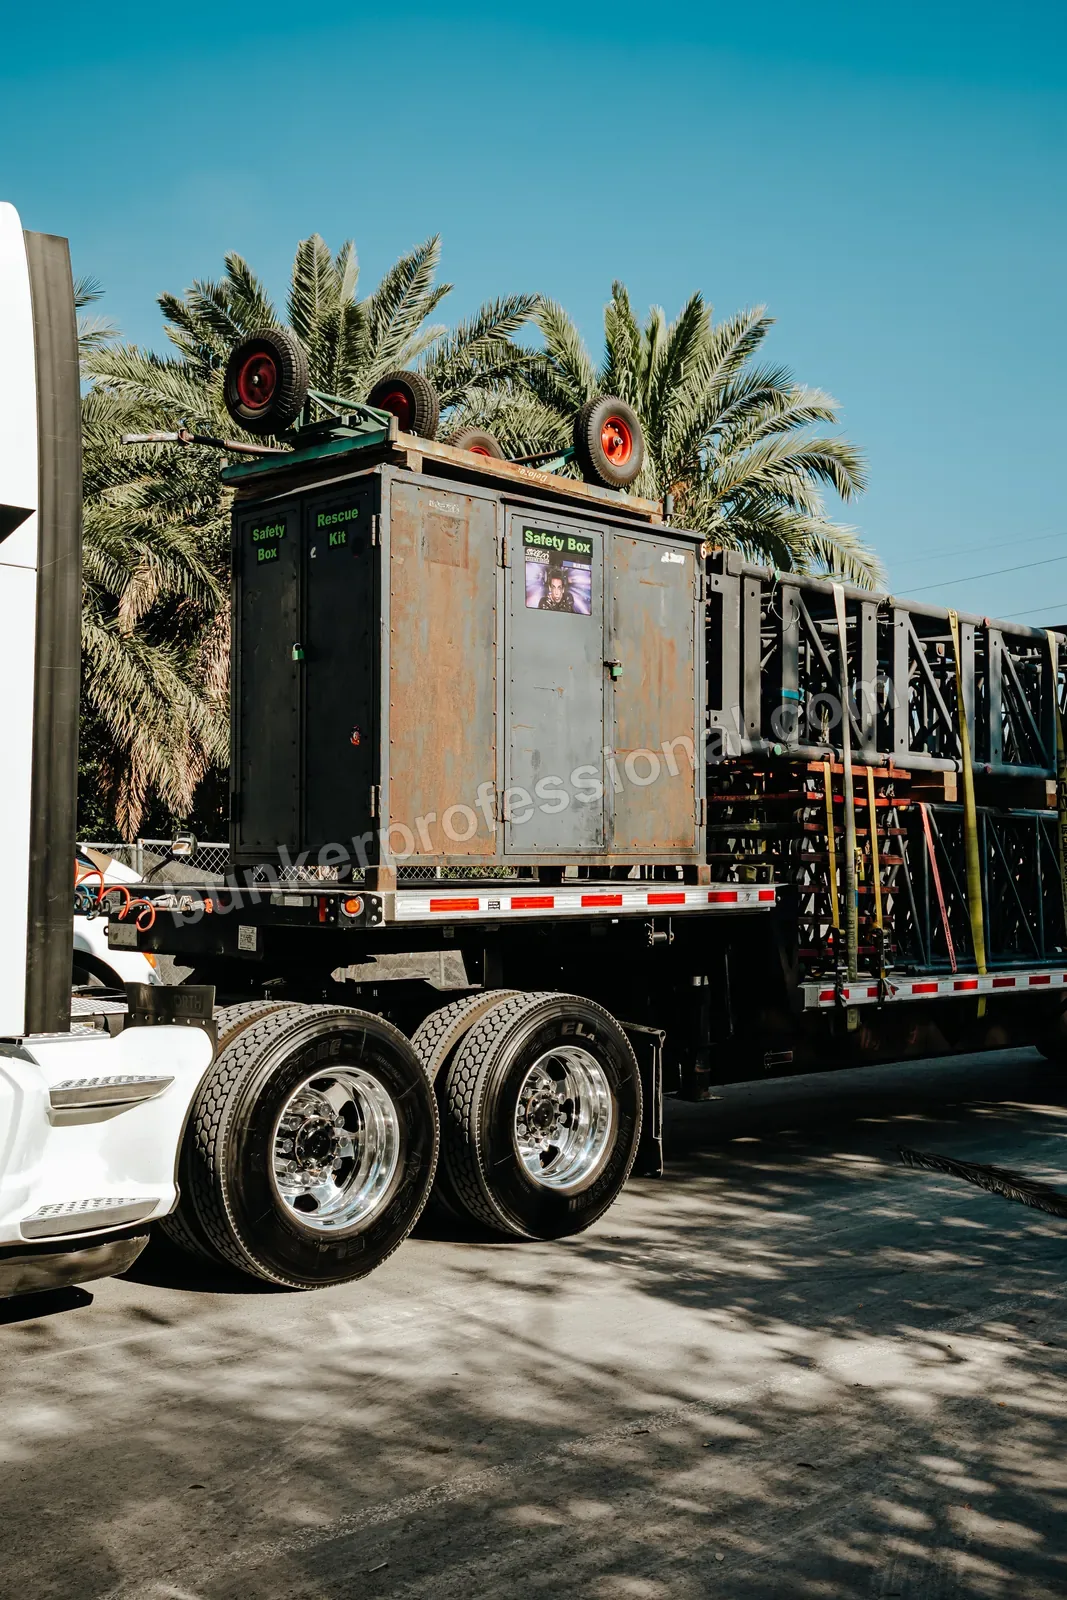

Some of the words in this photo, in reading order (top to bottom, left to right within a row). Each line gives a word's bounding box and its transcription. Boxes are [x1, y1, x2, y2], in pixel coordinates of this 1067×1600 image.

[317, 507, 359, 528] Rescue
[252, 523, 286, 542] Safety
[329, 530, 346, 546] Kit
[524, 530, 565, 552] Safety
[567, 540, 591, 554] Box
[257, 548, 277, 561] Box
